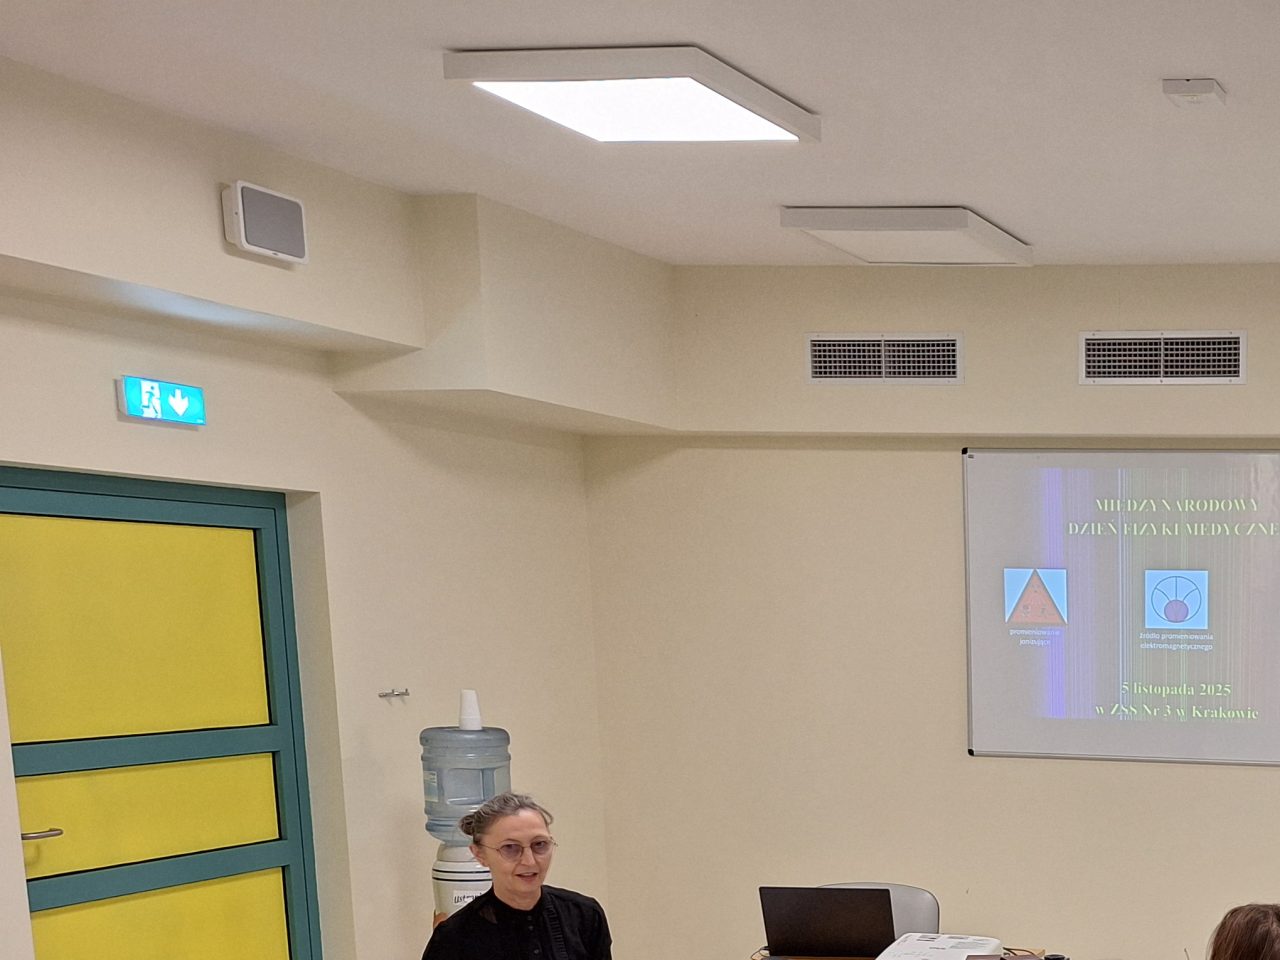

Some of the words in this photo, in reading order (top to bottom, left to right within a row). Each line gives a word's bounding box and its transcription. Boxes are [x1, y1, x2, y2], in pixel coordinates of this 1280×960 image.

[1068, 519, 1118, 536] DZIEŃ
[1123, 521, 1180, 536] FIZYKI
[1133, 681, 1195, 697] listopada
[1199, 683, 1232, 696] 2025
[1095, 705, 1105, 715] w
[1163, 705, 1172, 717] 3
[1176, 707, 1186, 718] w
[1191, 705, 1260, 719] Krakowie
